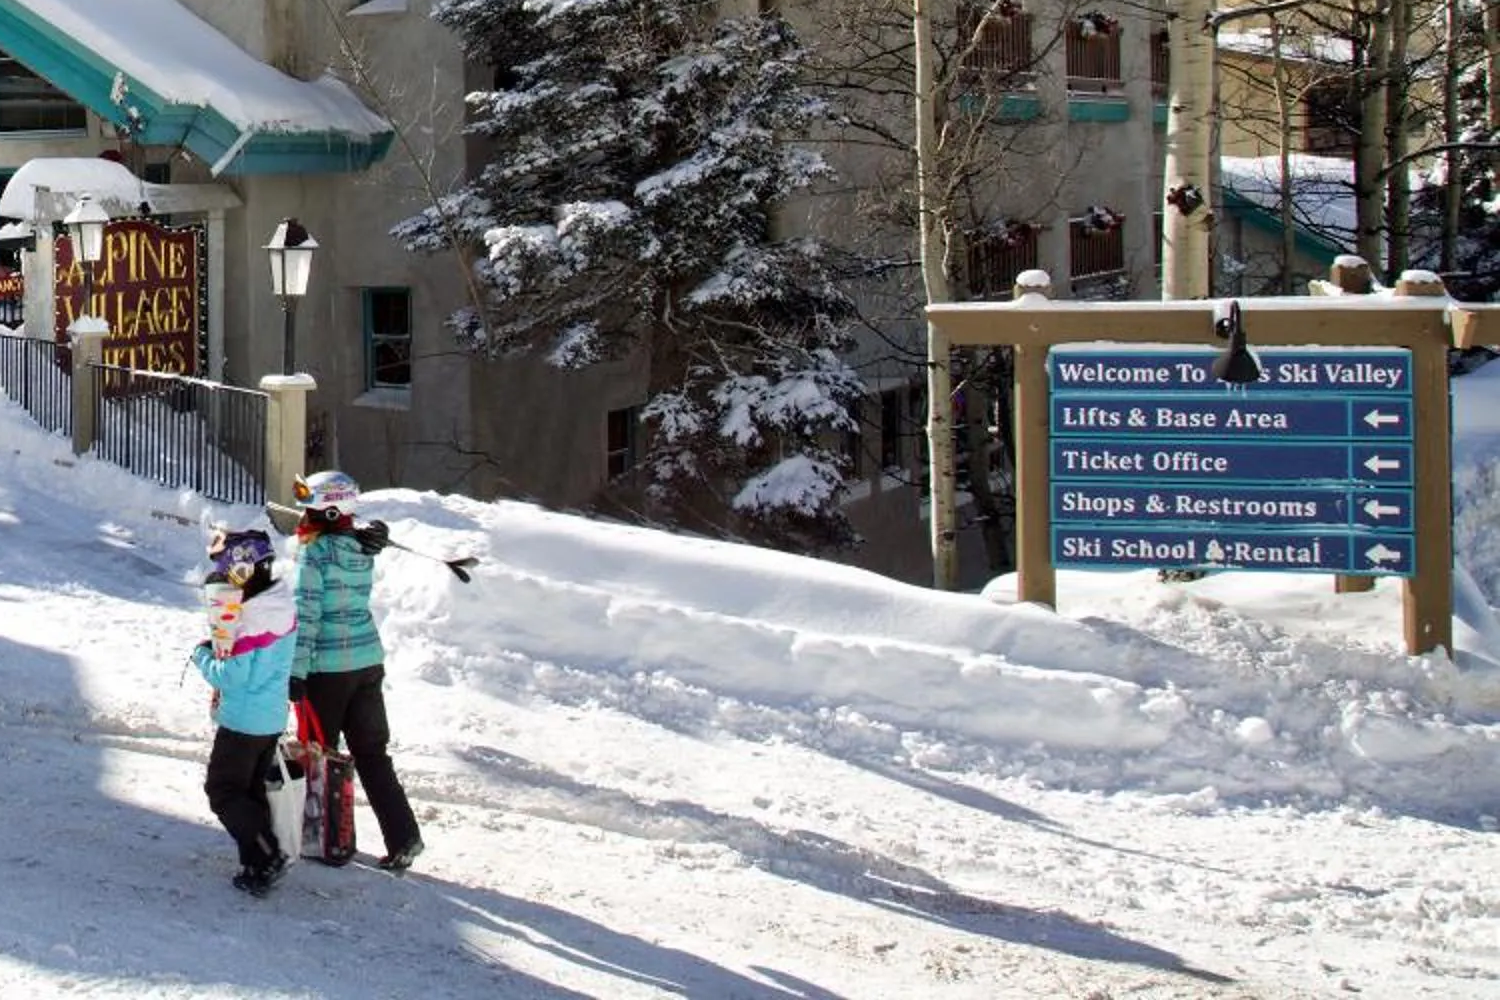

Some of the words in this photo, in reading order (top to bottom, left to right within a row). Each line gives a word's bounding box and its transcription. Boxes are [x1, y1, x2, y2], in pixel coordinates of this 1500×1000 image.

[1059, 363, 1169, 383] Welcome
[1176, 363, 1206, 383] To
[1278, 363, 1318, 383] Ski
[1325, 363, 1402, 388] Valley
[1063, 407, 1121, 427] Lifts
[1127, 408, 1147, 427] &
[1156, 408, 1217, 427] Base
[1225, 409, 1287, 429] Area
[1062, 450, 1144, 471] Ticket
[1153, 451, 1228, 472] Office
[1062, 493, 1135, 514] Shops
[1145, 495, 1165, 513] &
[1176, 496, 1317, 518] Restrooms
[1063, 538, 1101, 557] Ski
[1111, 538, 1195, 559] School
[1234, 538, 1321, 563] Rental
